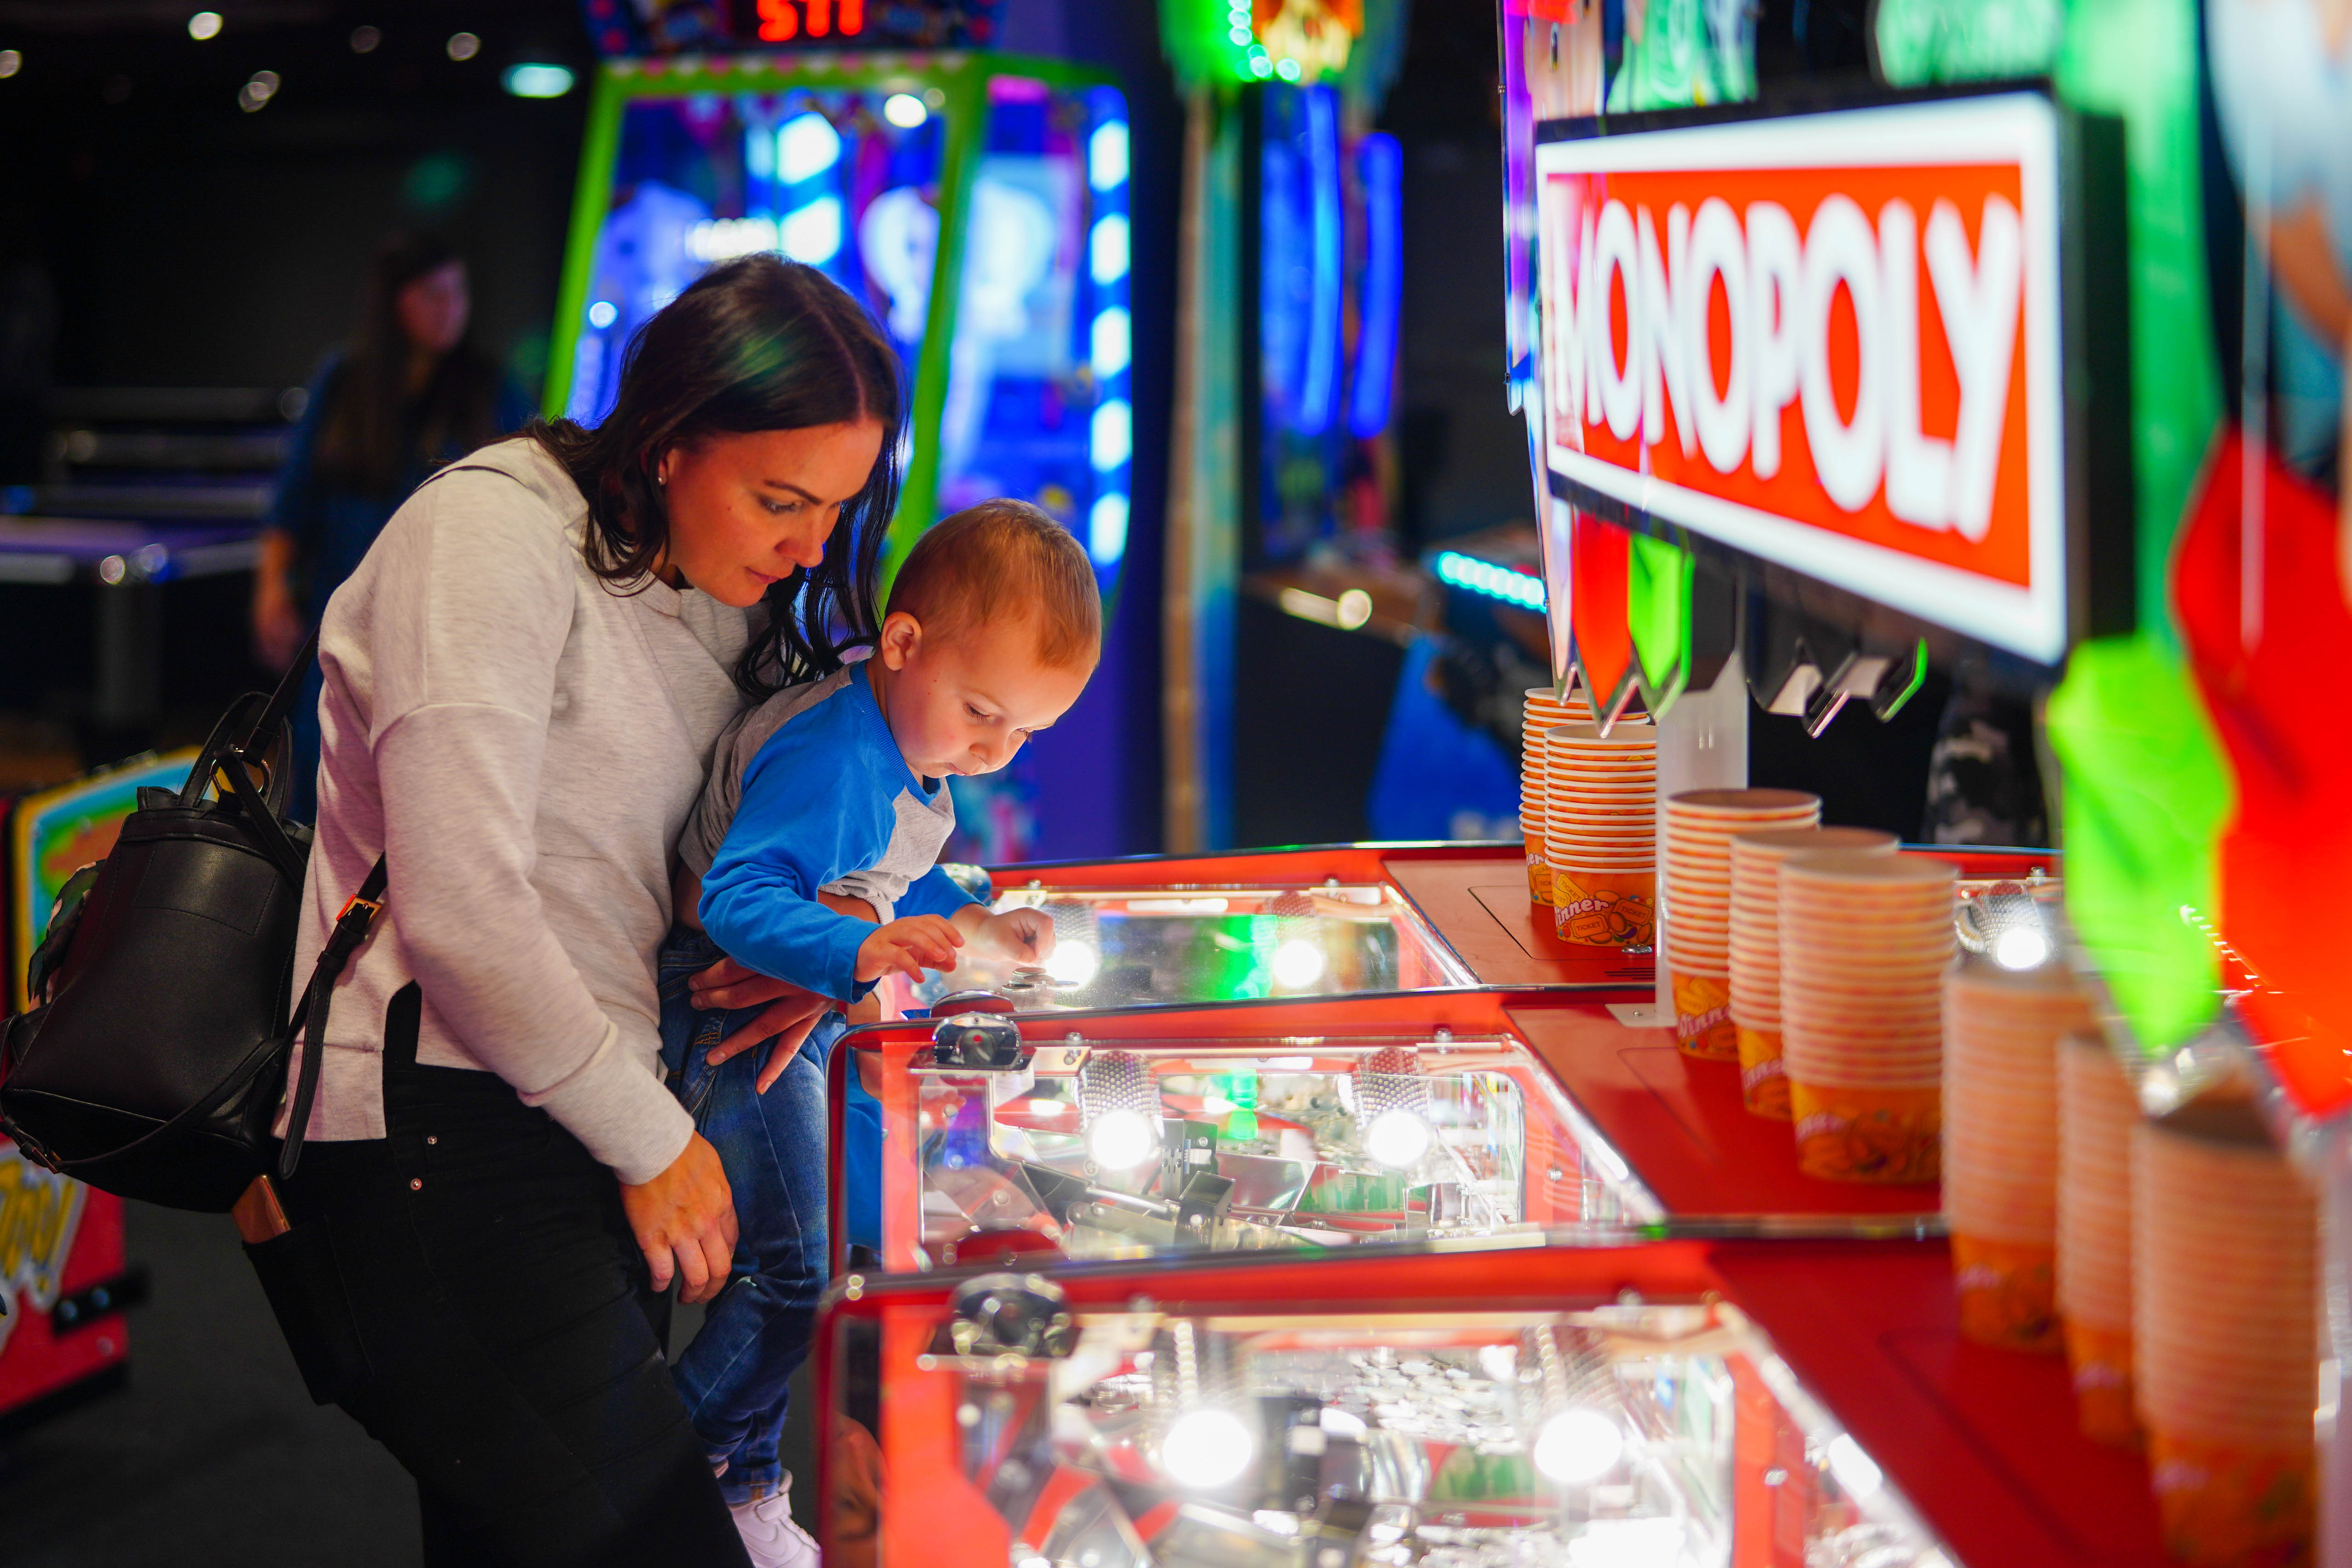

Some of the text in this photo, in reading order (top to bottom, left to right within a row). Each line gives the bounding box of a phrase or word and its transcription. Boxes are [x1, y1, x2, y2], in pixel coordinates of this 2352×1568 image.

[1550, 191, 2022, 543] MONOPOLY
[1561, 880, 1582, 900] TICKET
[1621, 906, 1646, 918] TICKET
[1576, 921, 1600, 932] TICKET
